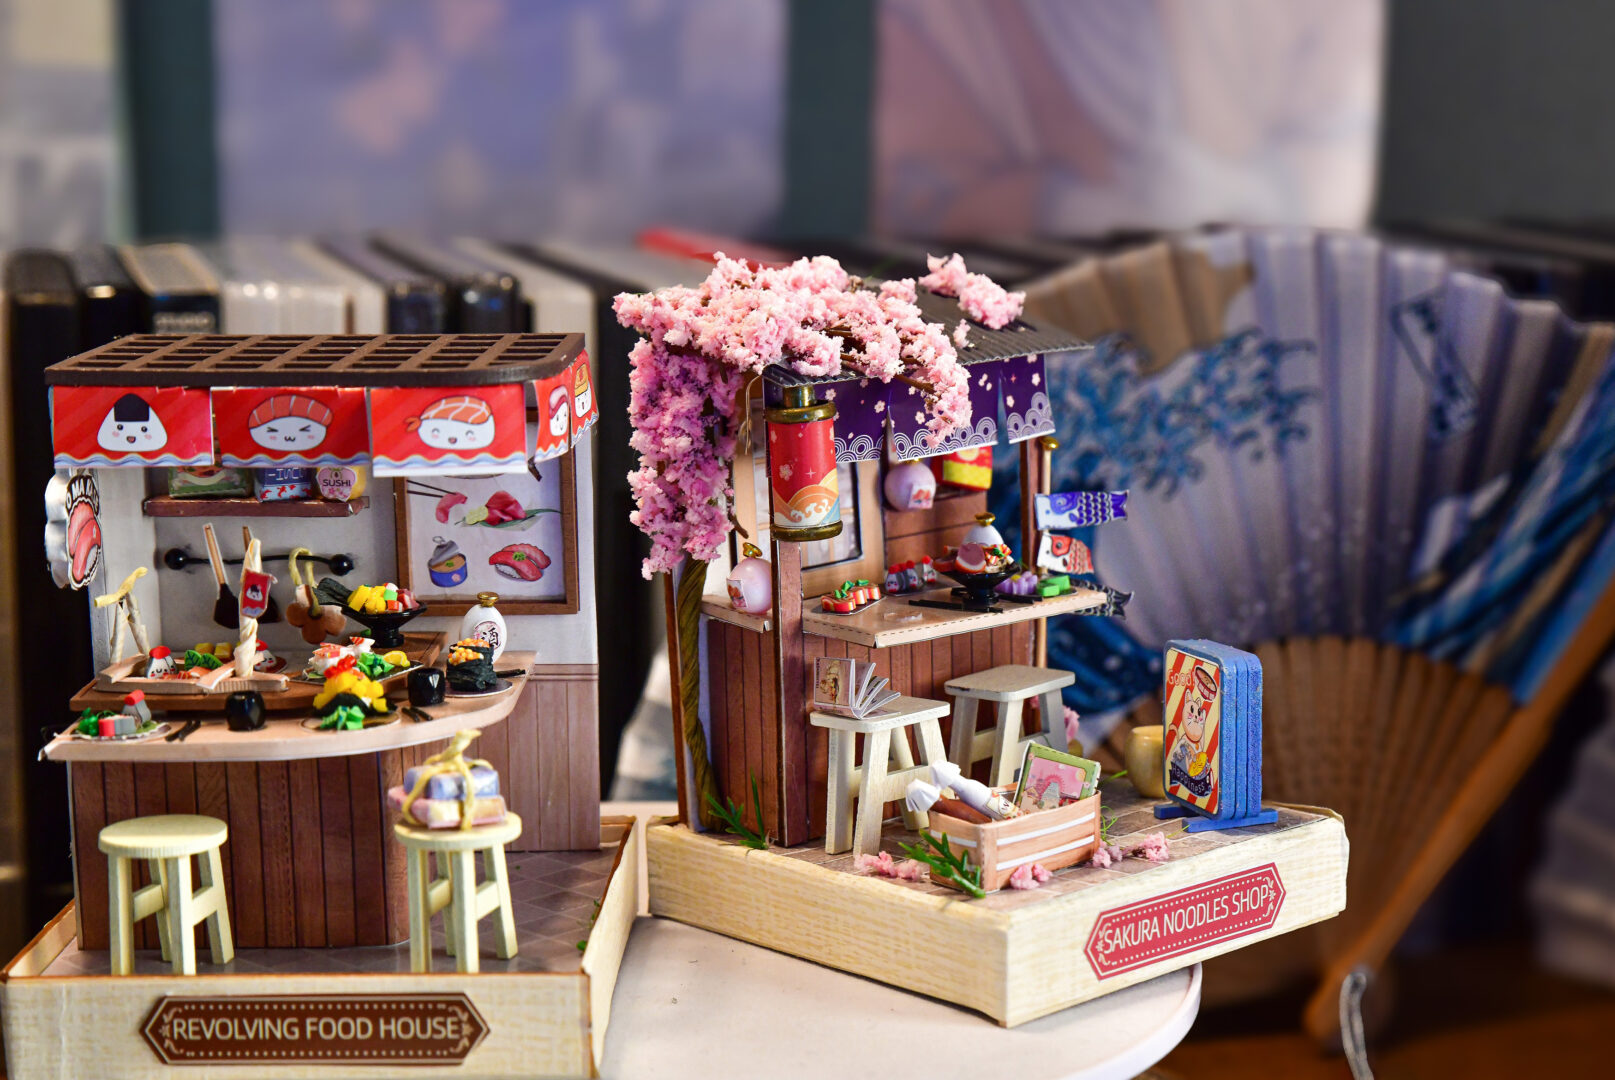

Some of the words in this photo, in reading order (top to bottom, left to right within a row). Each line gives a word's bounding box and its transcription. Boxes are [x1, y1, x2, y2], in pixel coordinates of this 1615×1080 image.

[322, 478, 351, 487] SUSHI
[480, 627, 499, 646] 酒
[1171, 763, 1205, 793] Happiness
[1103, 916, 1161, 955] SAKURA
[1163, 897, 1229, 937] NOODLES
[1231, 883, 1269, 916] SHOP
[172, 1017, 300, 1041] REVOLVING
[305, 1017, 373, 1040] FOOD
[379, 1016, 461, 1040] HOUSE
